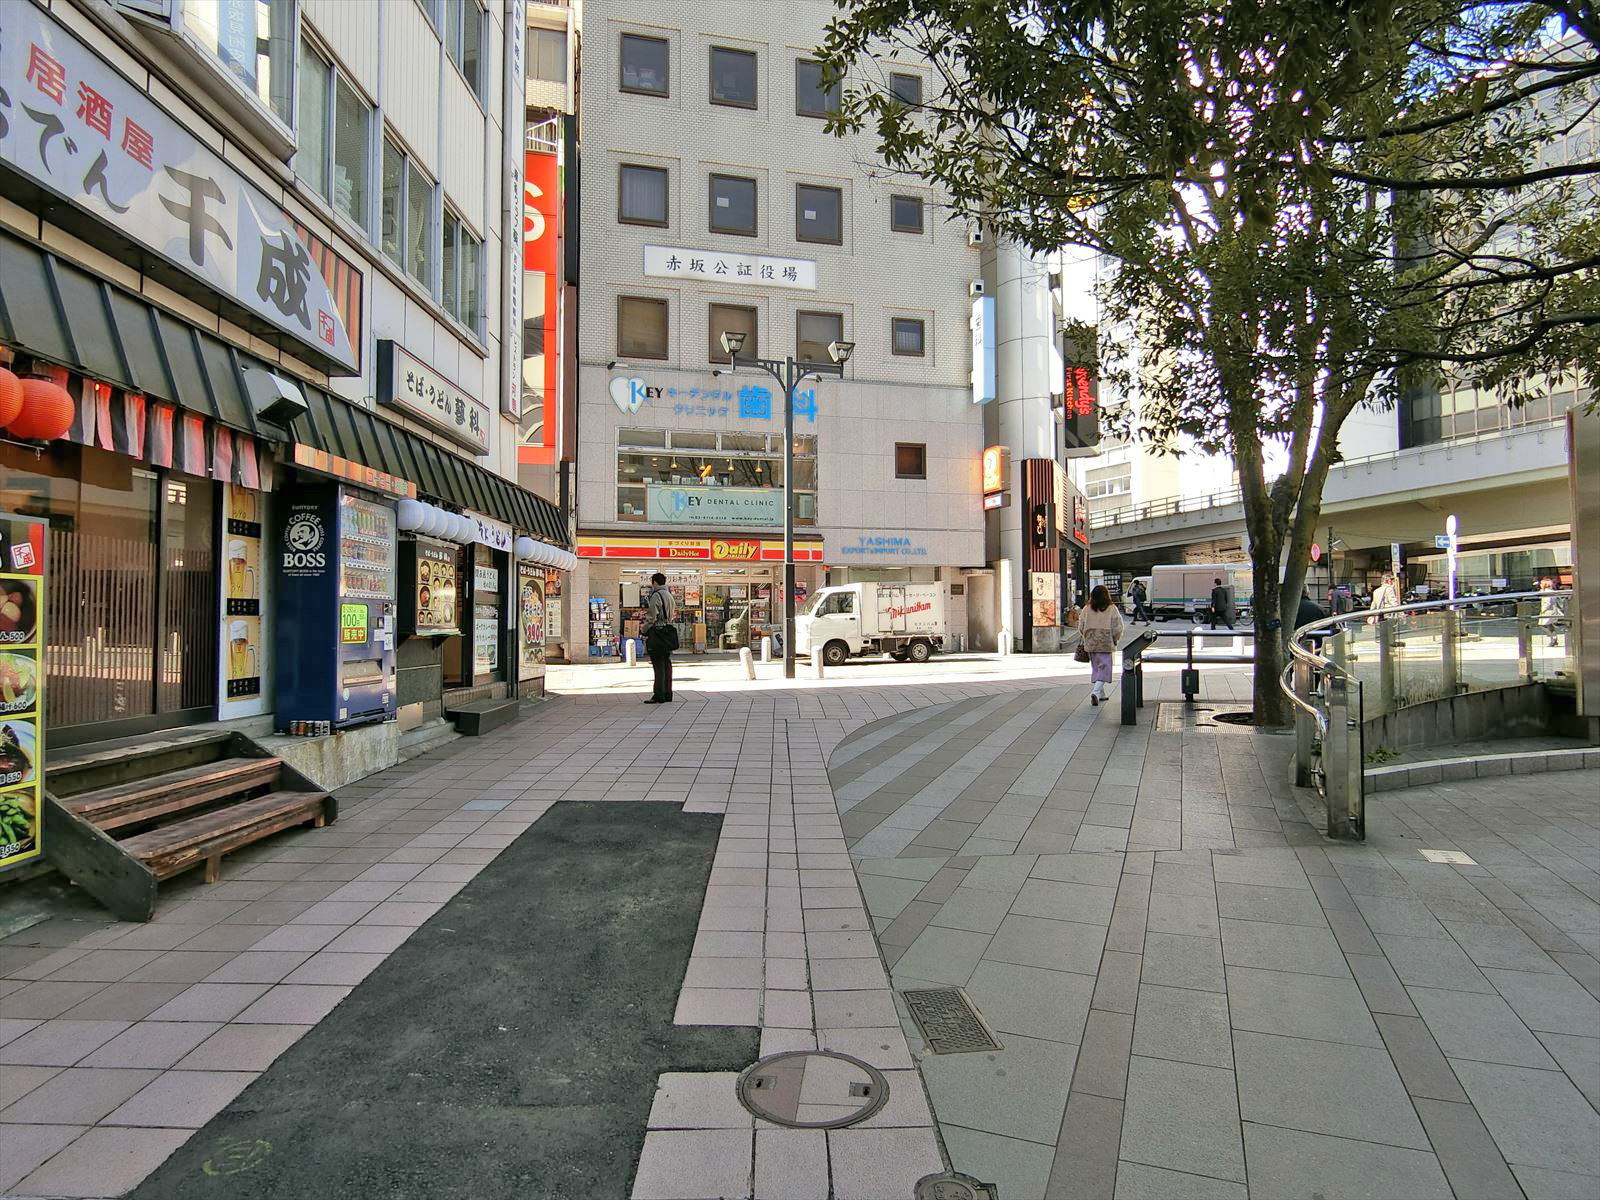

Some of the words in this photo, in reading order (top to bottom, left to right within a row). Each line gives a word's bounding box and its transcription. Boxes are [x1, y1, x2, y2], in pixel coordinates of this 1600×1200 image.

[26, 43, 154, 171] 居酒屋
[158, 165, 311, 330] 千成
[666, 255, 798, 282] 赤坂公証役場
[406, 369, 452, 415] そば・うどん
[630, 381, 664, 404] KEY
[707, 498, 740, 506] DENTAL
[288, 513, 322, 525] COFFEE
[858, 535, 912, 546] YASHIMA
[713, 541, 758, 559] Daily
[283, 553, 326, 567] BOSS
[343, 613, 356, 627] 100
[10, 631, 24, 641] 500
[14, 701, 26, 710] 600
